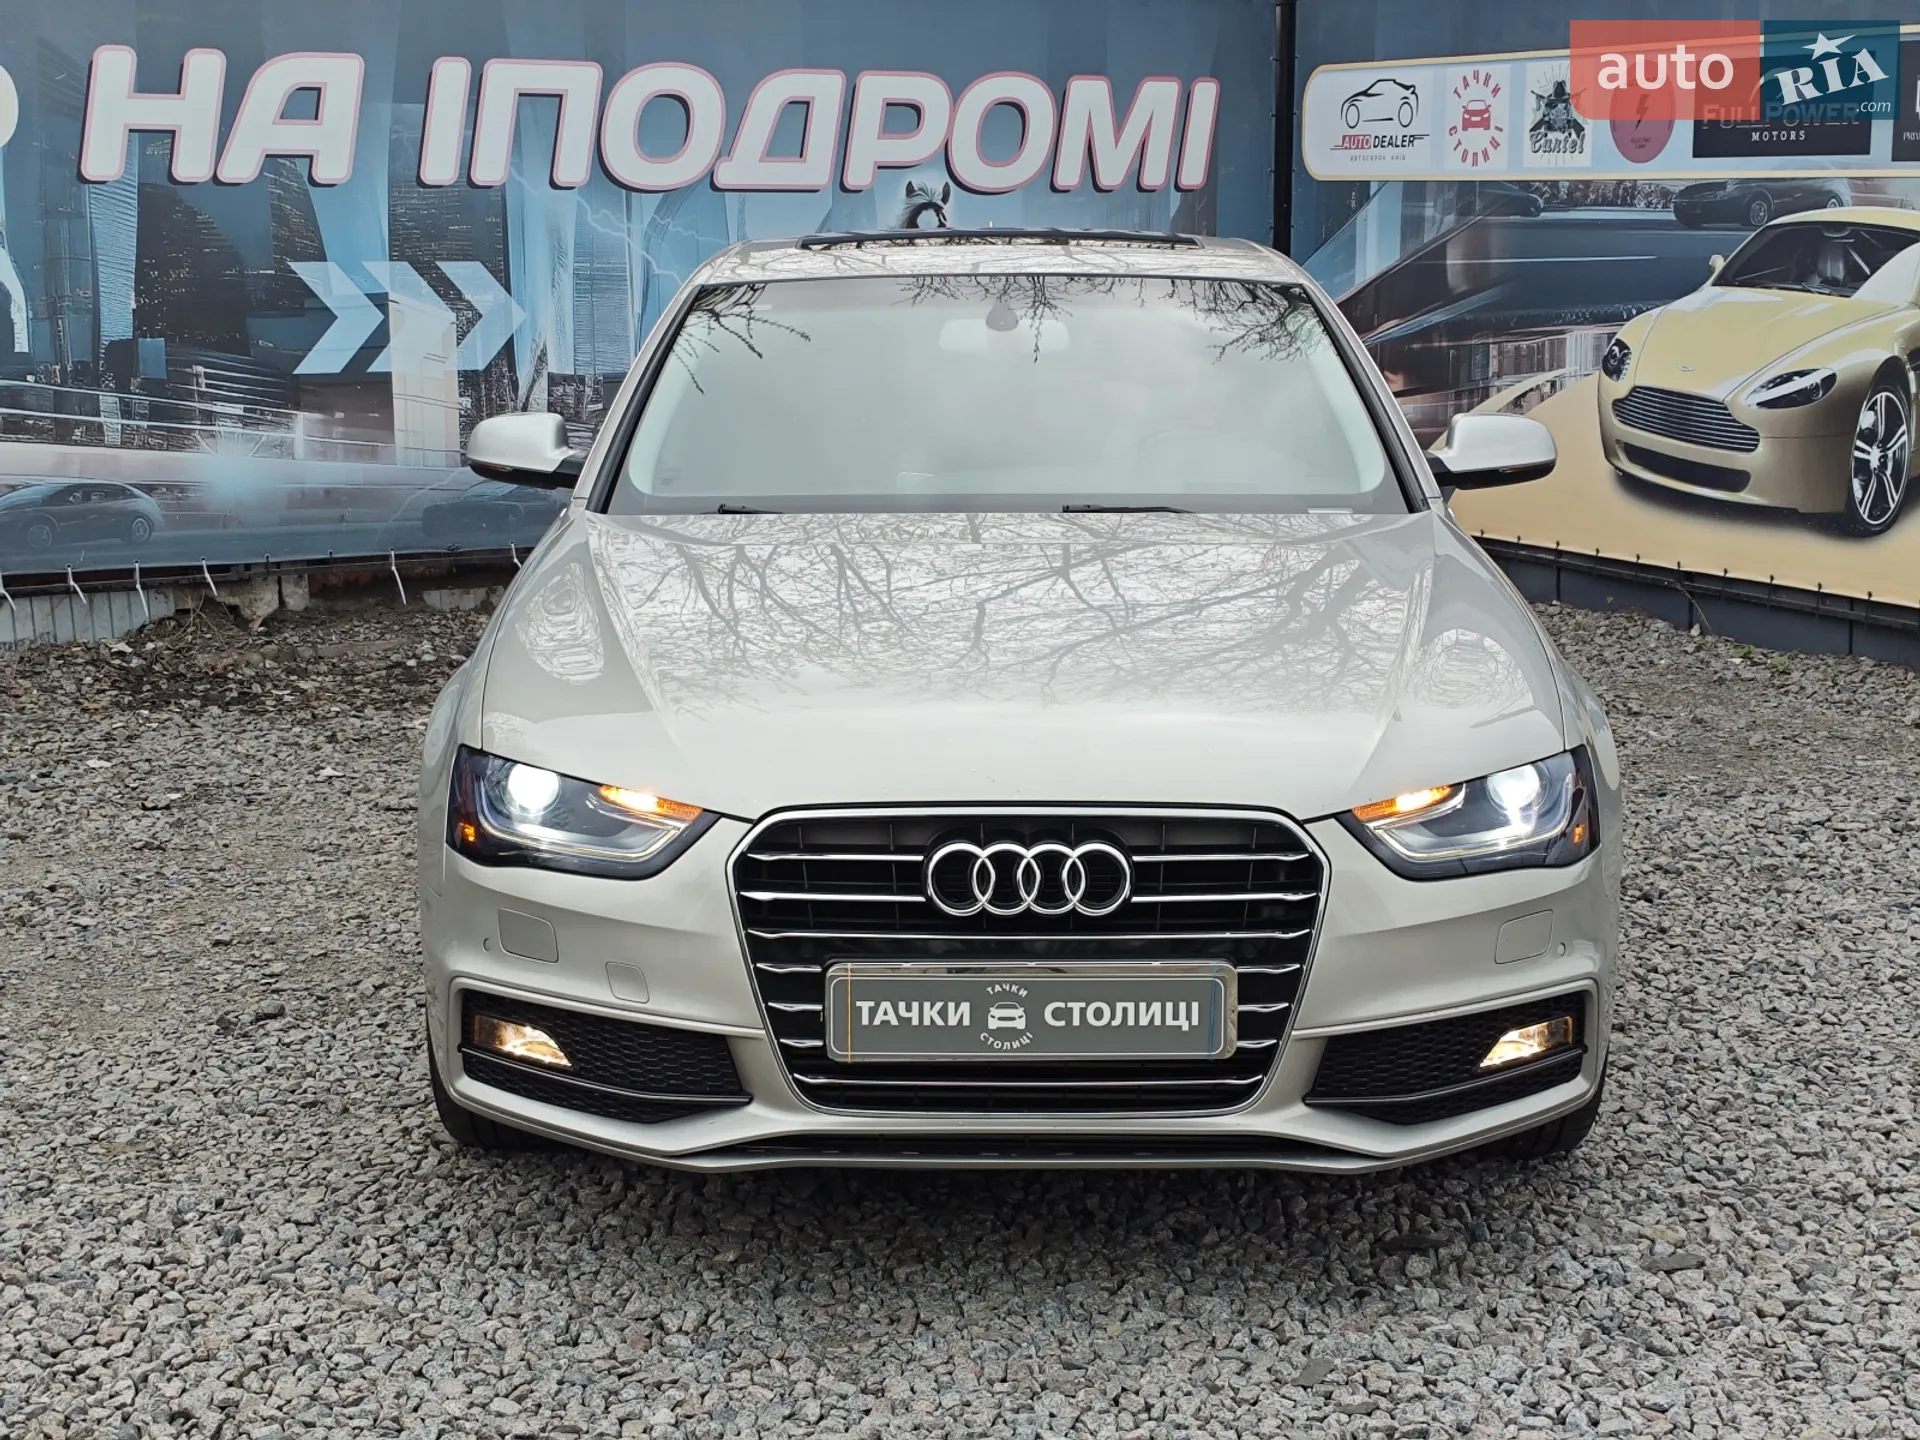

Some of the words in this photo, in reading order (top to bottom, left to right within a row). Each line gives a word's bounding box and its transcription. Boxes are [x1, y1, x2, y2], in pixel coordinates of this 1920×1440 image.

[1453, 70, 1502, 99] ТАЧКИ
[79, 45, 365, 185] НА
[418, 56, 1220, 194] ІПОДРОМІ
[1342, 135, 1371, 149] AUTO
[1373, 134, 1416, 148] DEALER
[1448, 125, 1504, 167] СТОЛИЦІ
[1751, 130, 1805, 142] MOTORS
[986, 983, 1028, 998] ТАЧКИ
[856, 1001, 970, 1026] ТАЧКИ
[1043, 1001, 1199, 1031] СТОЛИЦІ
[980, 1032, 1033, 1050] СТОЛИЦІ
